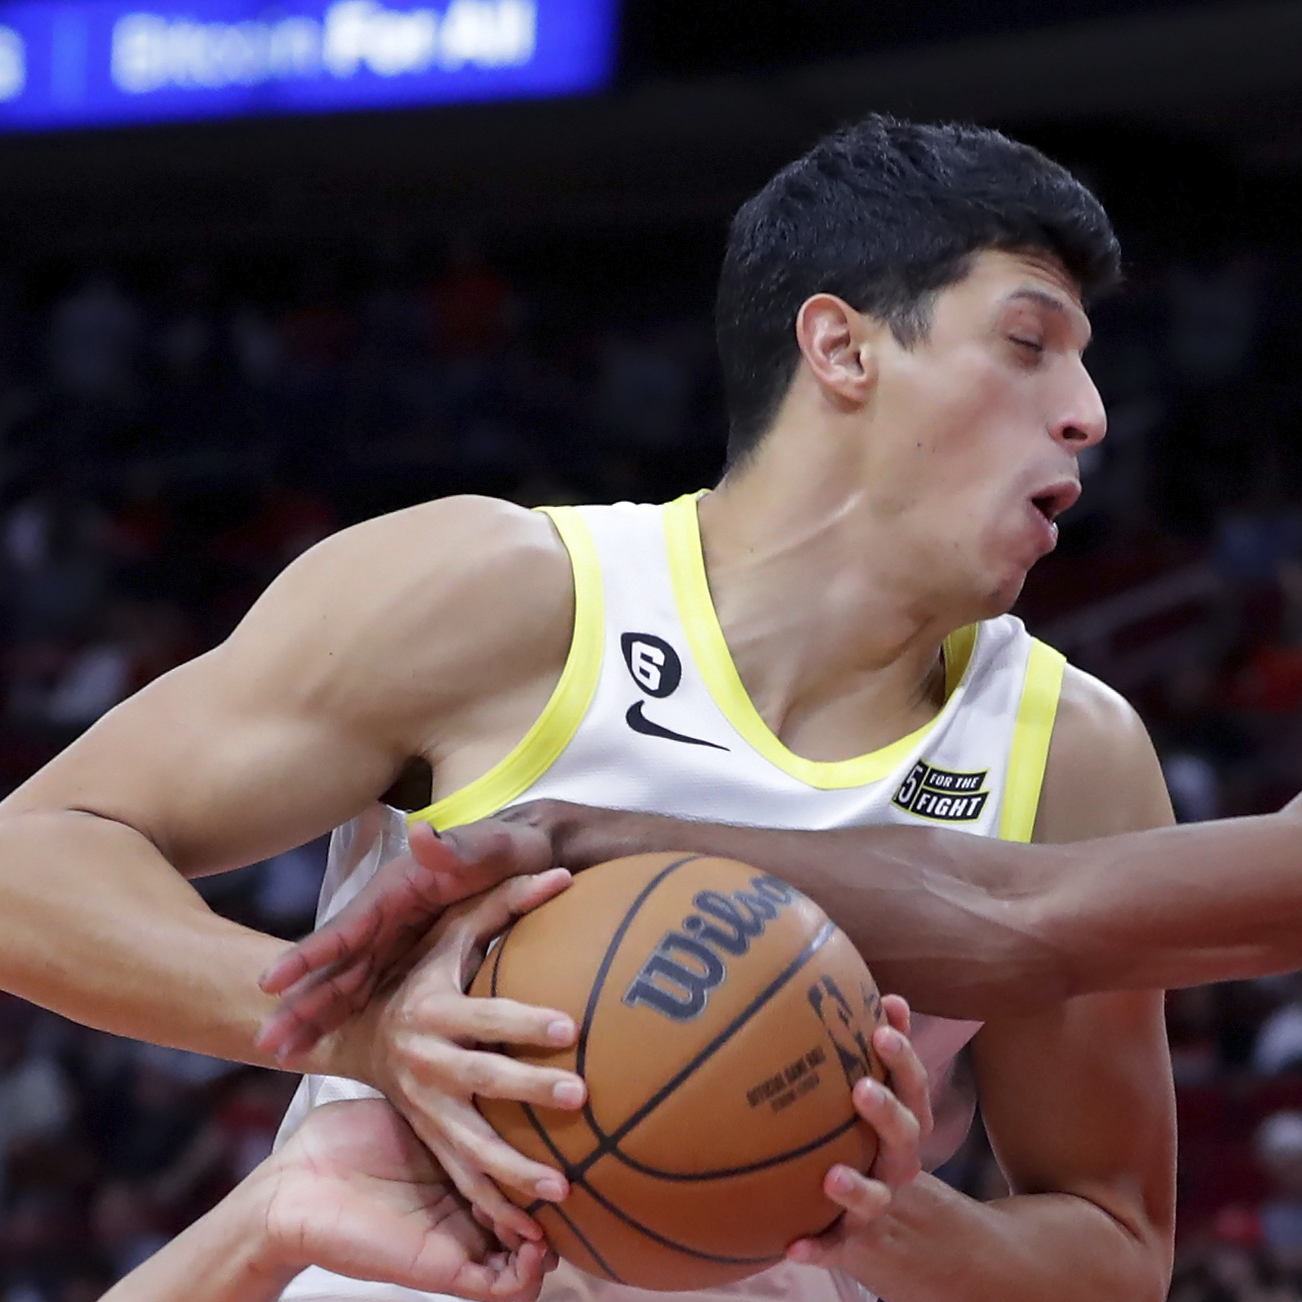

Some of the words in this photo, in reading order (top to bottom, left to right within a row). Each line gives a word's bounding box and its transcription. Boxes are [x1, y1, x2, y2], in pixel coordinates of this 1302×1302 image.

[631, 640, 666, 691] 6
[898, 764, 924, 803] 5
[929, 773, 953, 788] FOR
[955, 776, 980, 789] THE
[916, 793, 982, 817] FIGHT
[622, 873, 794, 1023] Wilso
